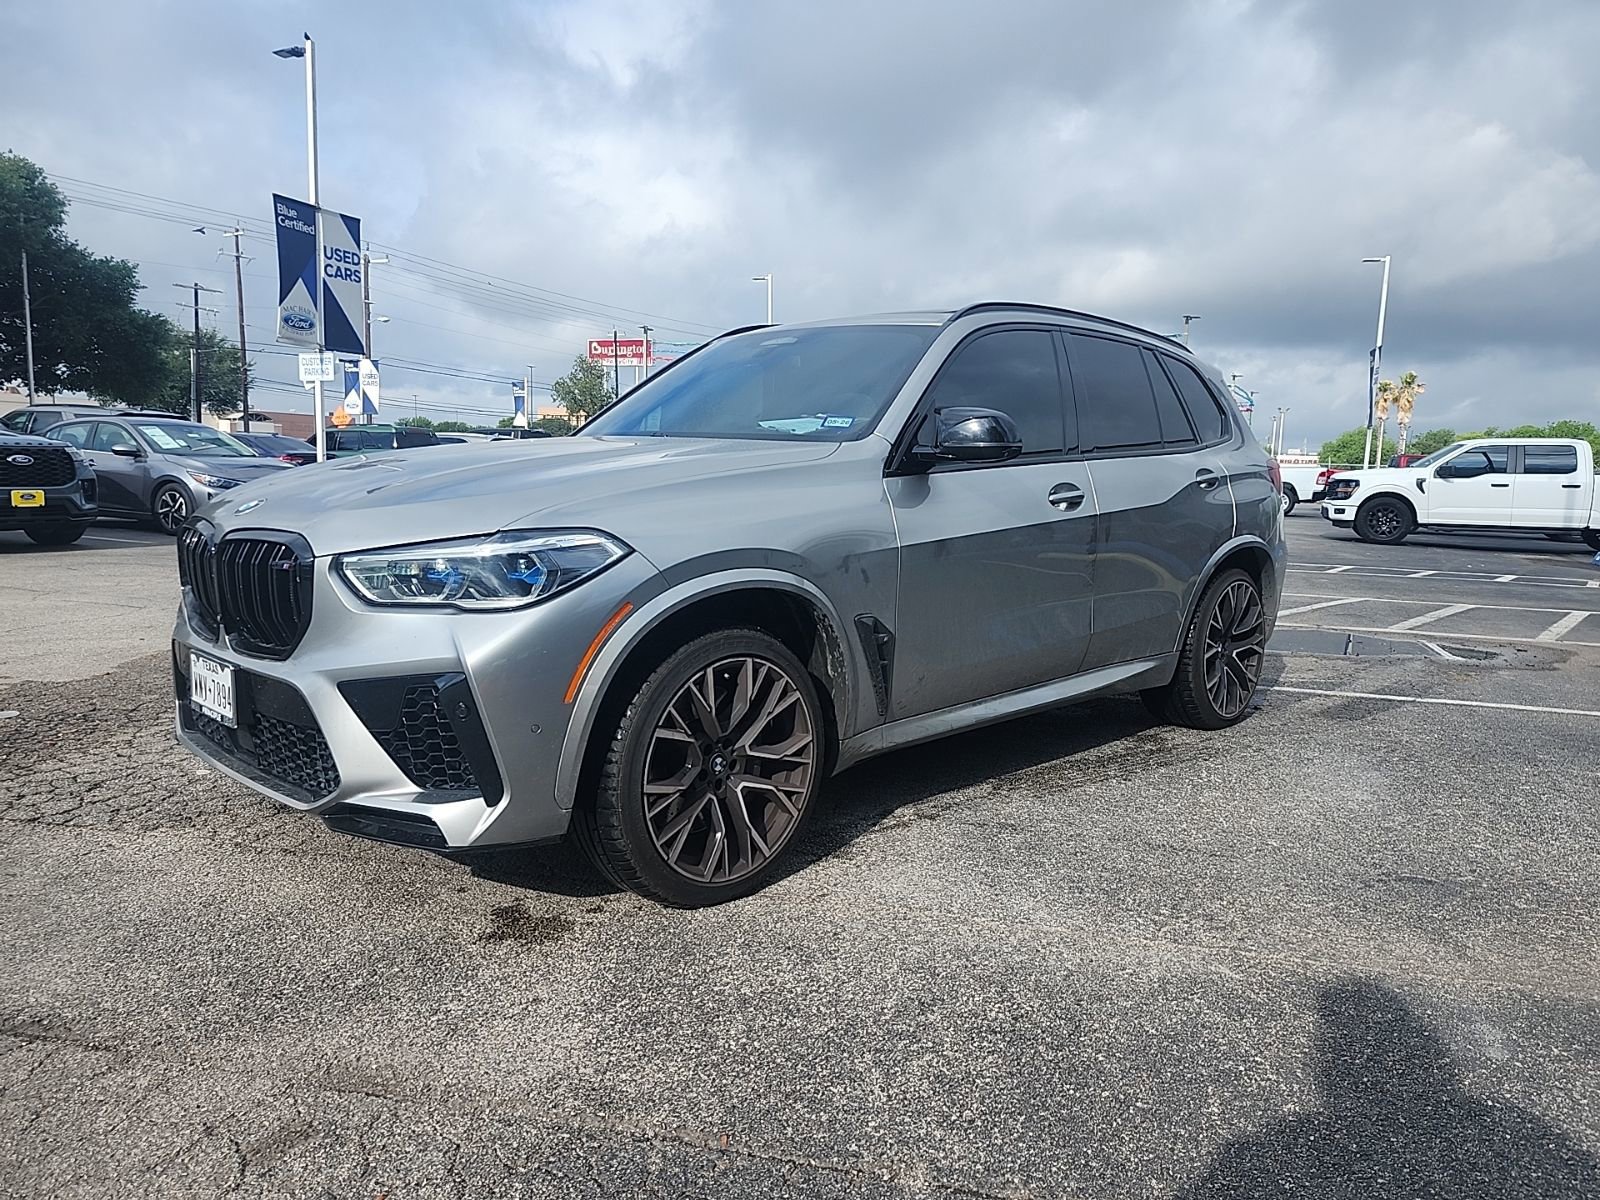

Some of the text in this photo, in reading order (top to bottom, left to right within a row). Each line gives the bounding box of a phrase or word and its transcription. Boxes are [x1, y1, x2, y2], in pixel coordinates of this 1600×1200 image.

[277, 203, 298, 219] Blue
[278, 215, 316, 236] Certified
[324, 245, 361, 267] USED
[324, 263, 361, 284] CARS
[288, 313, 311, 329] Ford
[301, 357, 332, 367] CUSTOER
[361, 379, 379, 387] CARS
[201, 659, 219, 675] TEXAS
